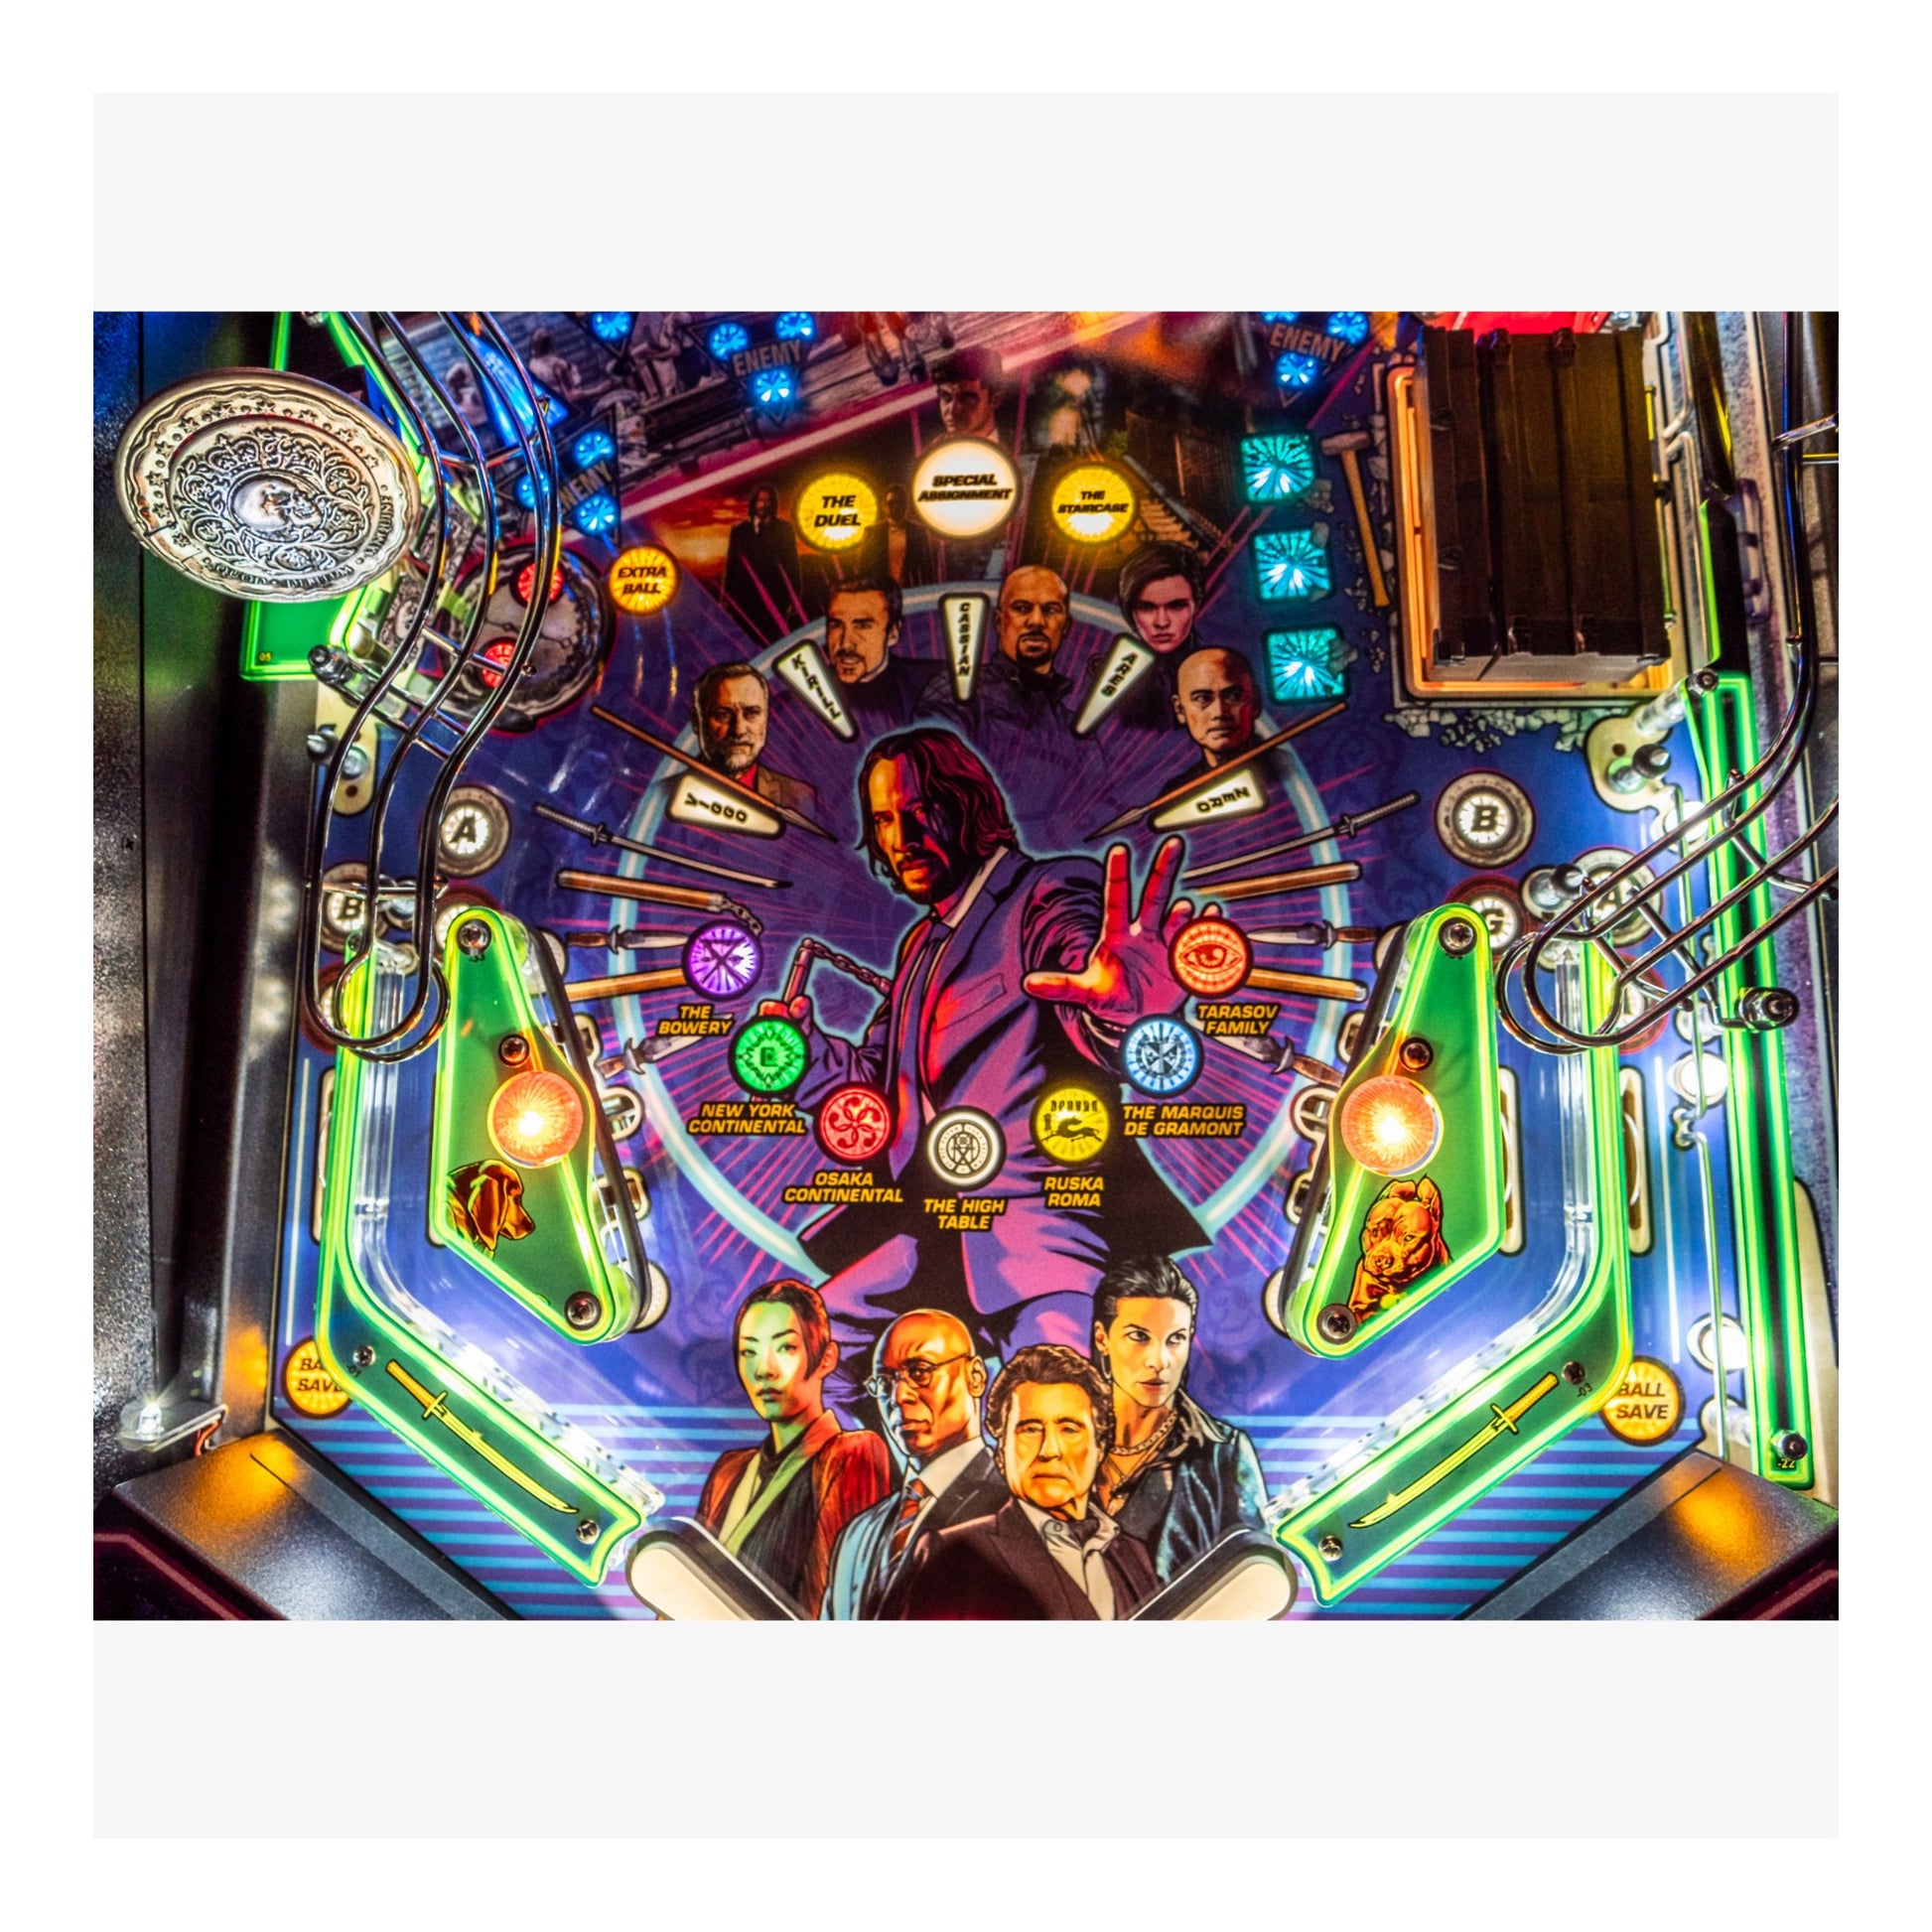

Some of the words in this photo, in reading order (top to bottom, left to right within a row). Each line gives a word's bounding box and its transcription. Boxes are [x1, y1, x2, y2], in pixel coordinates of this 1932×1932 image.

[1271, 323, 1345, 363] ENEMY
[733, 339, 802, 377] ENEMY
[558, 459, 614, 515] NEMY
[931, 474, 998, 487] SPECIAL
[821, 494, 857, 508] THE
[917, 487, 1013, 502] ASSIGNMENT
[1080, 490, 1106, 500] THE
[1057, 502, 1130, 513] STAIRCASE
[814, 513, 862, 528] DUEL
[618, 566, 668, 579] EXTRA
[621, 583, 662, 595] BALL
[957, 602, 971, 676] CASSIAN
[1100, 652, 1139, 698] ARES
[791, 653, 842, 720] KIRILL
[1195, 785, 1251, 813] ZERO
[684, 792, 749, 824] VIGGO
[1470, 804, 1500, 832] B
[449, 815, 478, 844] A
[338, 895, 363, 920] B
[1480, 907, 1505, 935] G
[679, 1005, 713, 1020] THE
[1197, 1004, 1279, 1020] TARASOV
[658, 1021, 733, 1035] BOWERY
[1205, 1021, 1270, 1035] FAMILY
[701, 1103, 745, 1118] NEW
[749, 1103, 795, 1118] YORK
[1123, 1105, 1156, 1120] THE
[1161, 1105, 1245, 1120] MARQUIS
[688, 1119, 806, 1134] CONTINENTAL
[1124, 1122, 1148, 1136] DE
[1153, 1122, 1244, 1136] GRAMONT
[814, 1172, 874, 1186] OSAKA
[1044, 1176, 1105, 1191] RUSKA
[783, 1188, 904, 1203] CONTINENTAL
[1047, 1192, 1102, 1207] ROMA
[923, 1199, 956, 1213] THE
[961, 1199, 1006, 1213] HIGH
[937, 1215, 991, 1229] TABLE
[1618, 1382, 1666, 1397] BALL
[1615, 1404, 1669, 1420] SAVE
